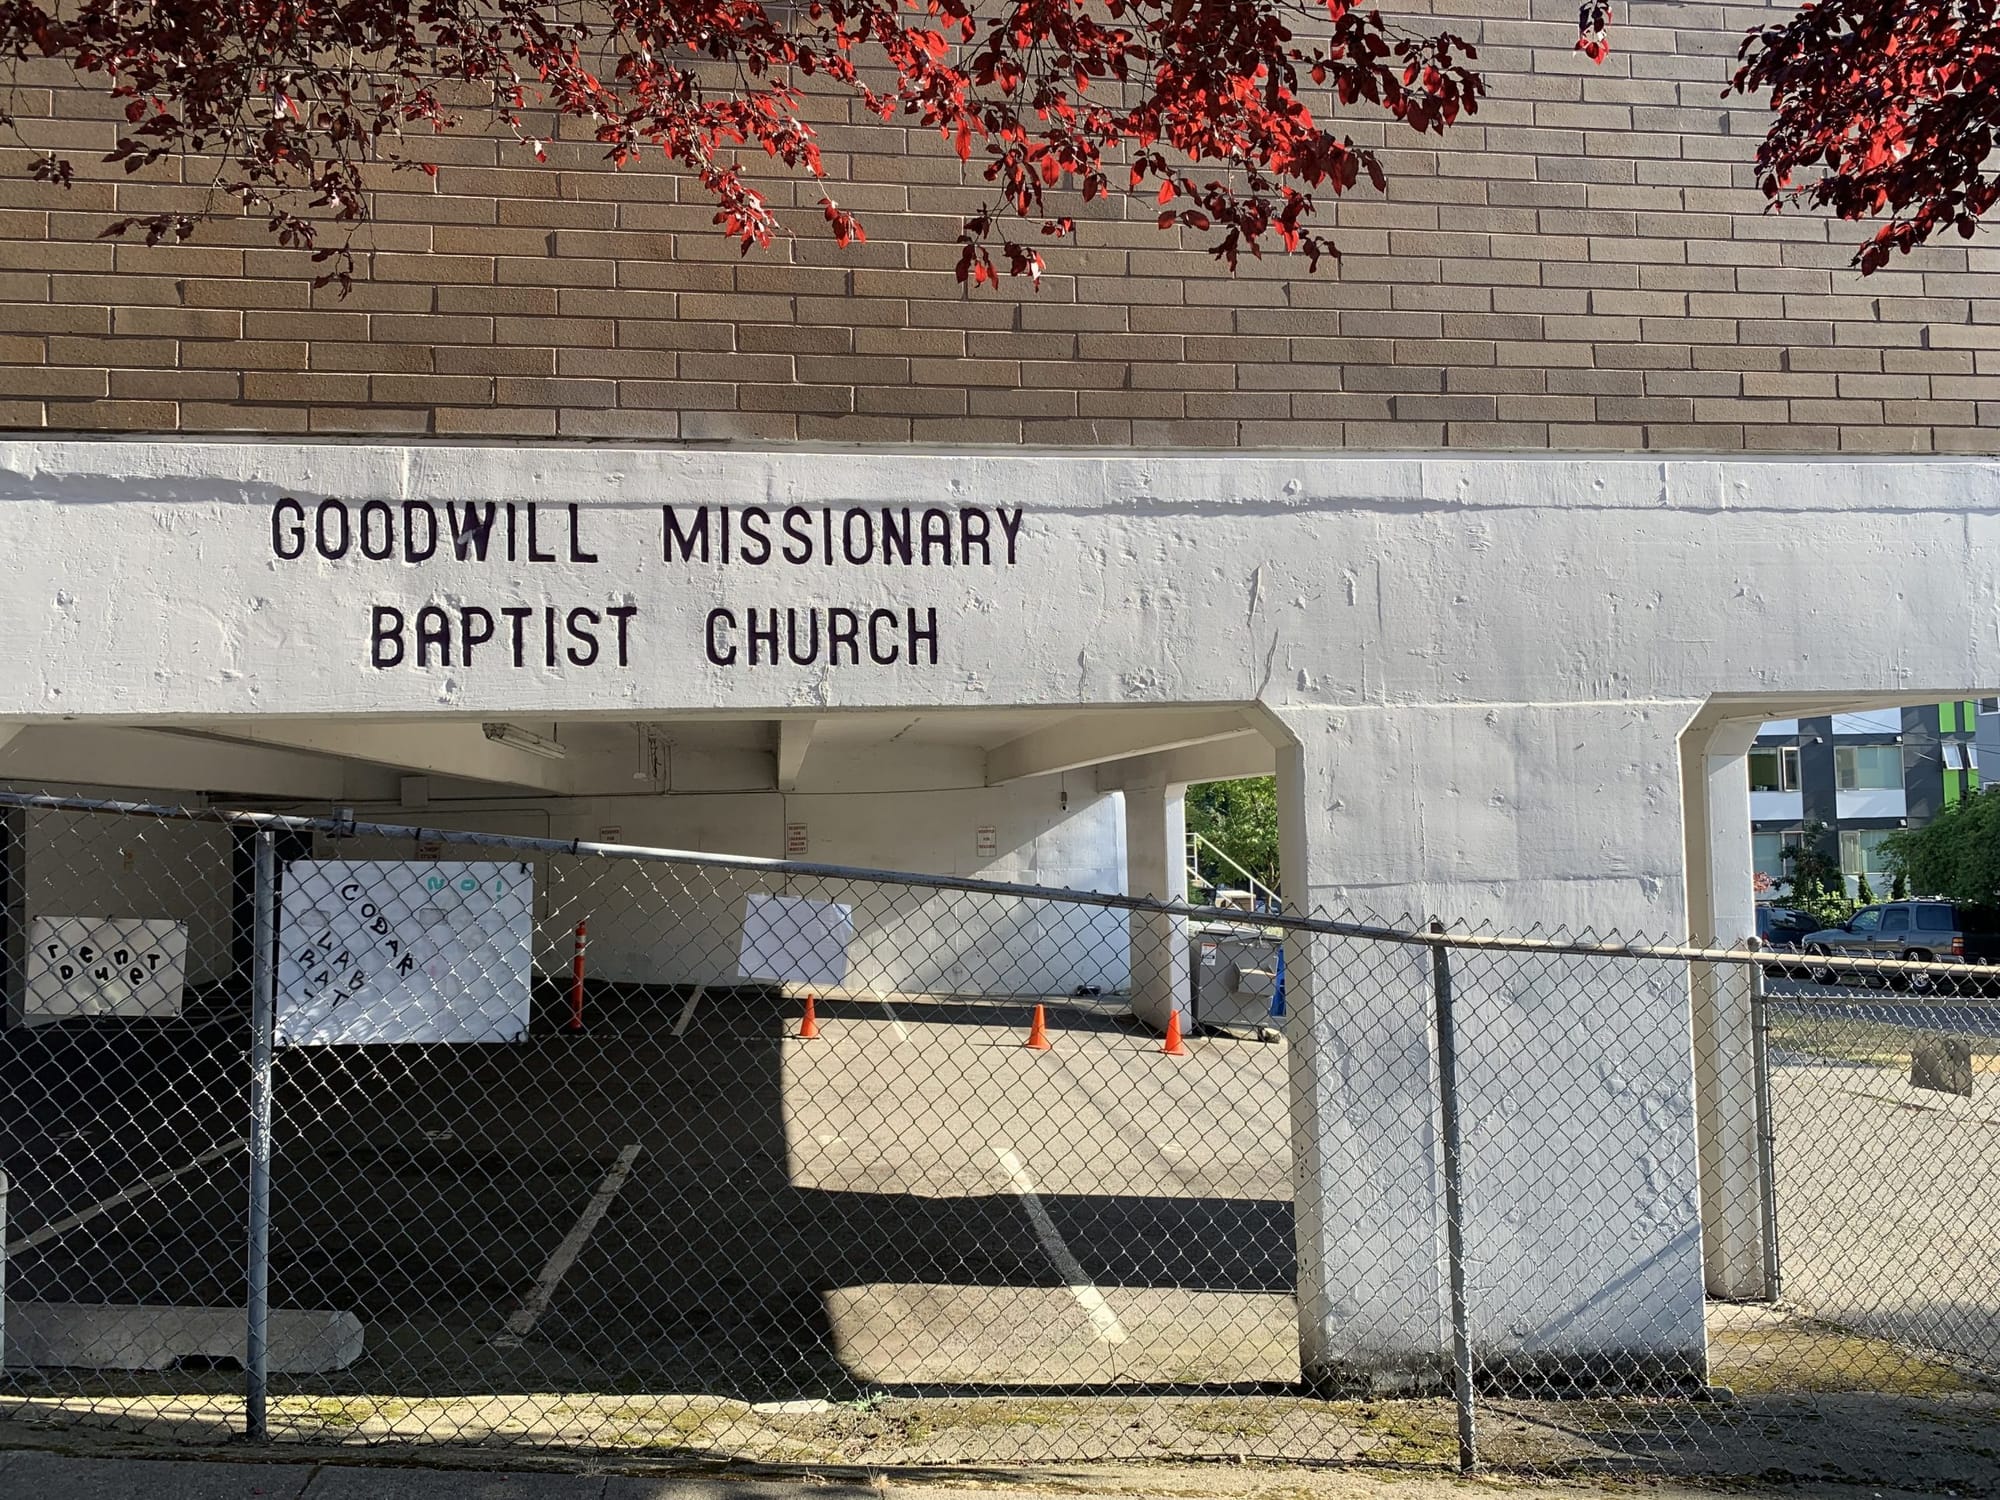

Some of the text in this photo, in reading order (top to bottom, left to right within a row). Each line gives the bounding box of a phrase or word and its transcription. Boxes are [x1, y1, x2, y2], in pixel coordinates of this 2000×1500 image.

[271, 498, 1023, 566] GOODWILL MISSIONARY
[371, 606, 938, 668] BAPTIST CHURCH
